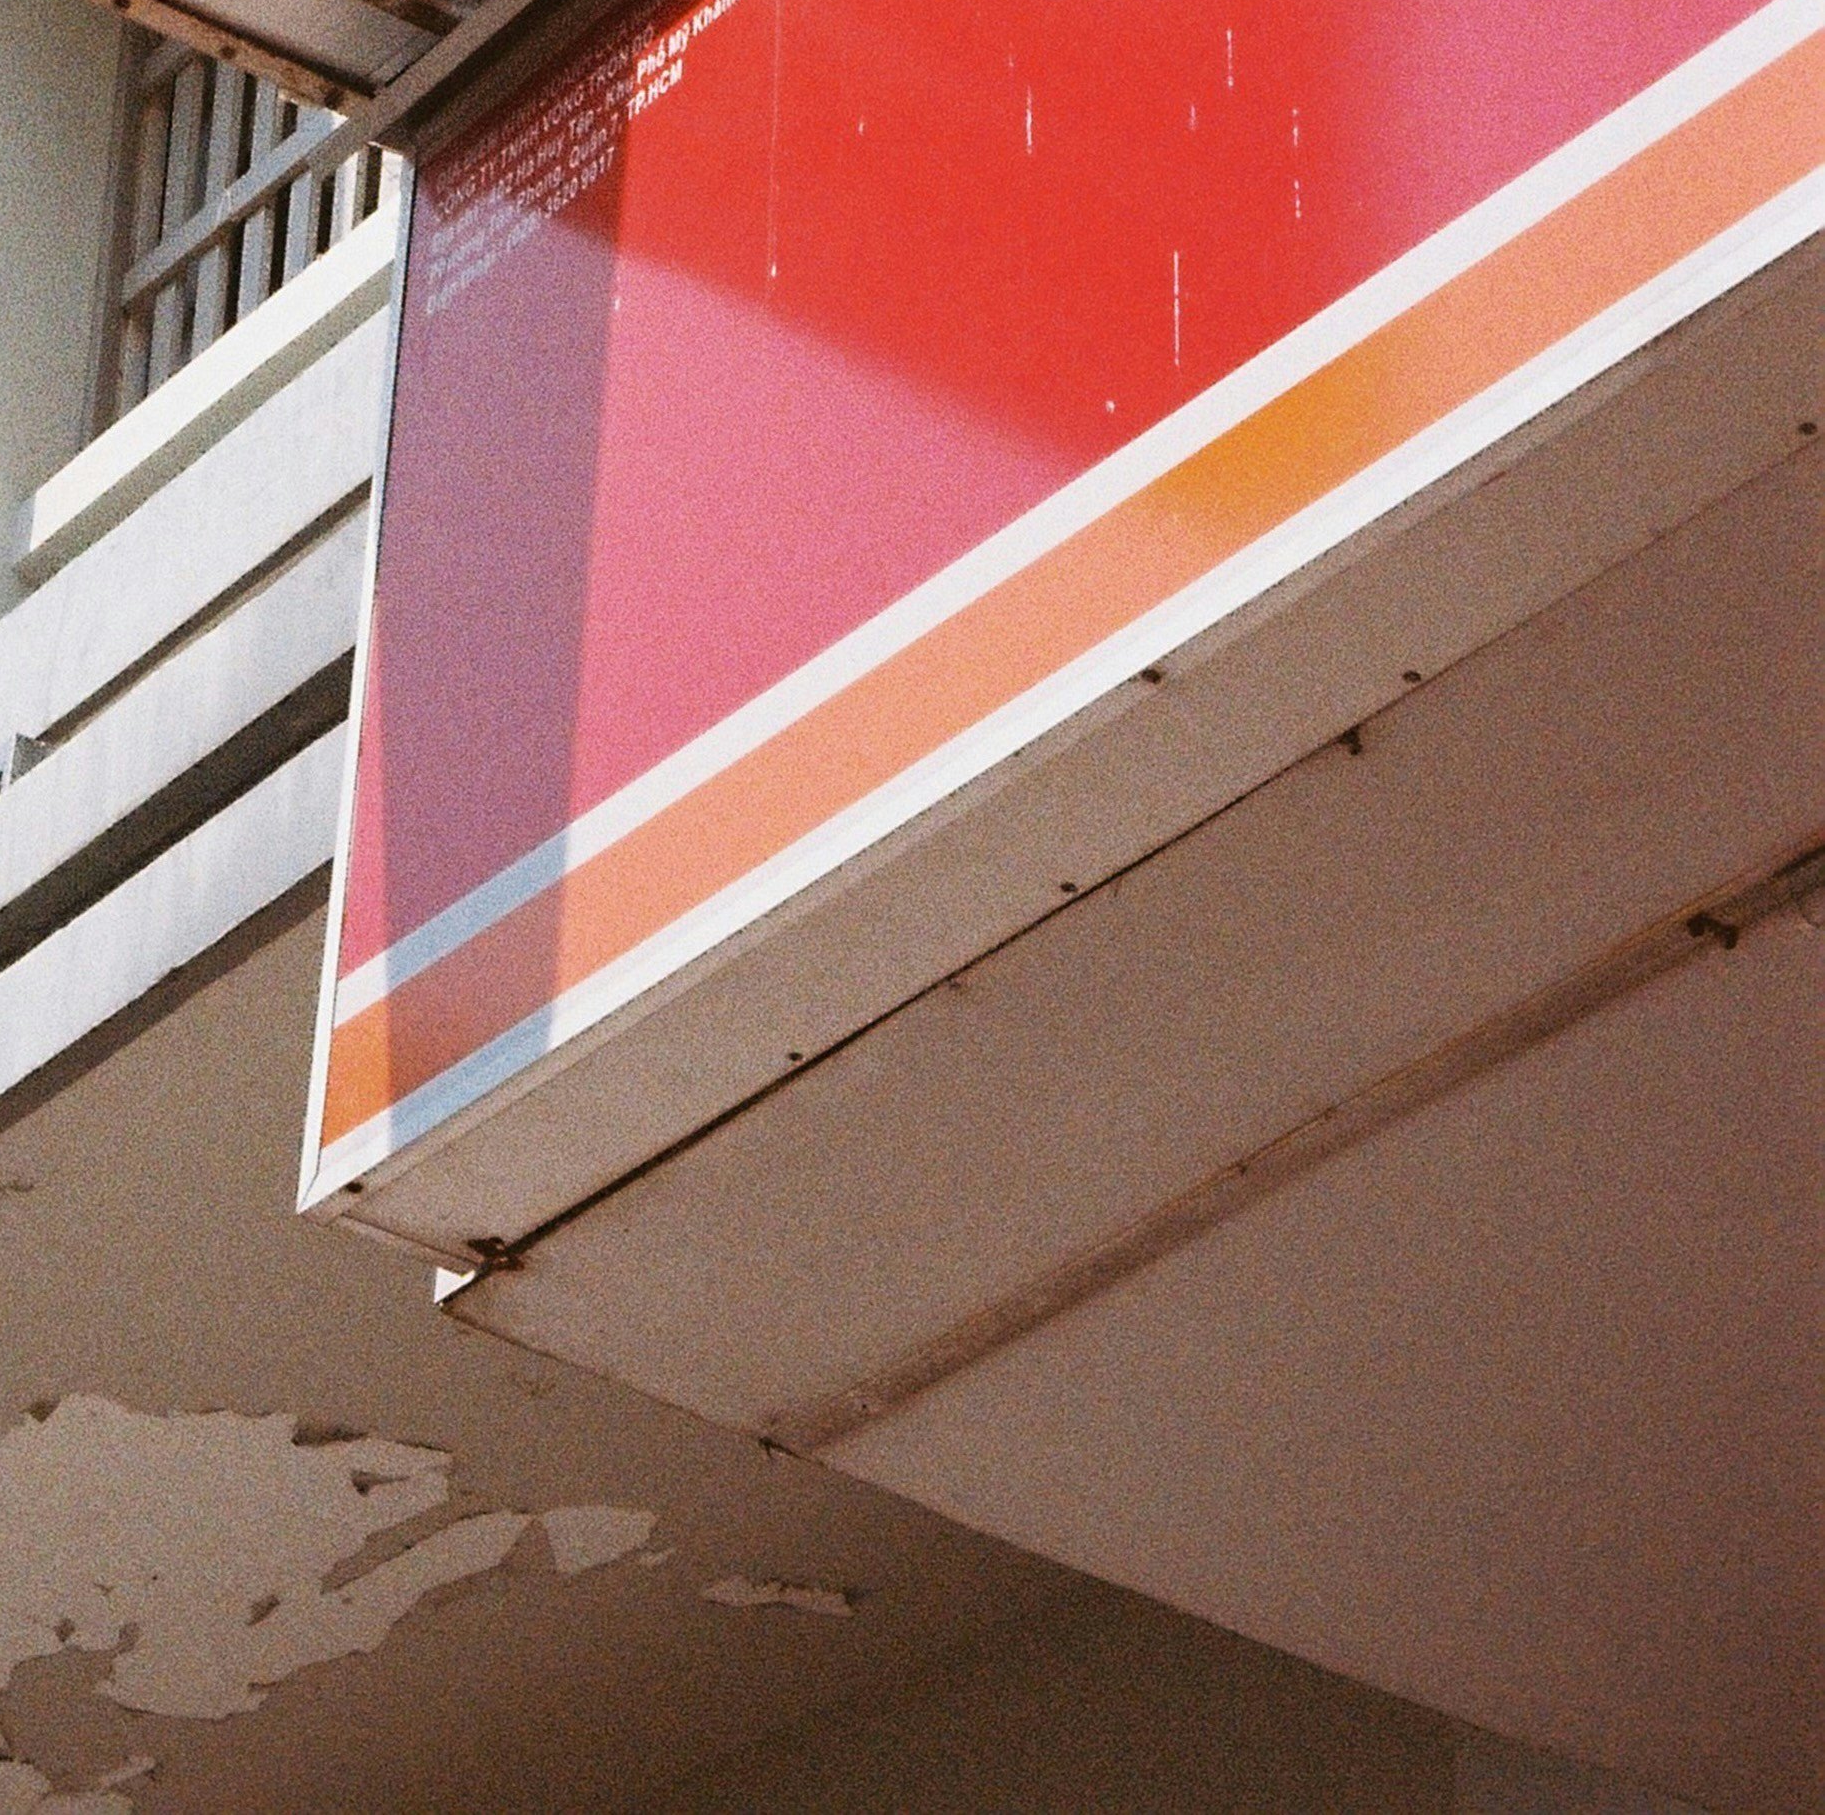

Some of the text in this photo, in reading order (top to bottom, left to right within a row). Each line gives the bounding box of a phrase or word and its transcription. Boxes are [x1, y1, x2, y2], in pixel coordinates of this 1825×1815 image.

[636, 34, 666, 87] Phố
[668, 17, 689, 65] Mỹ
[626, 58, 683, 124] TP.HCM
